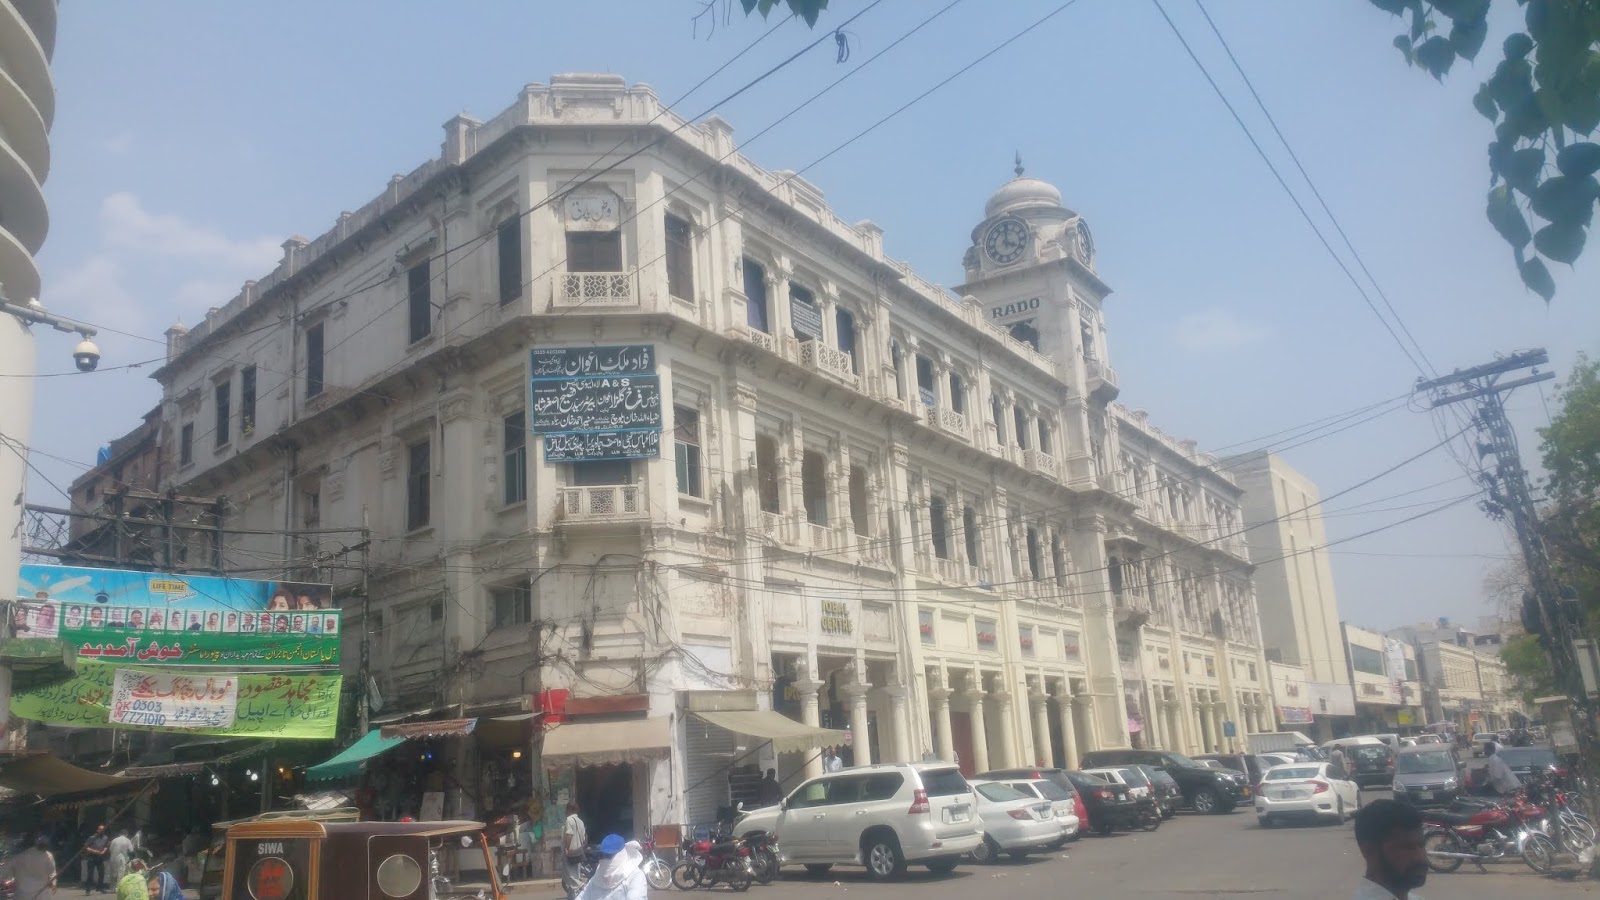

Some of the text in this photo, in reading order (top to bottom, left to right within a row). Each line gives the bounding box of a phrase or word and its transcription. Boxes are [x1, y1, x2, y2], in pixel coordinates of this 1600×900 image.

[992, 297, 1040, 319] RADO
[565, 351, 598, 375] اعوان
[600, 346, 629, 371] ملک
[601, 379, 610, 387] A
[621, 378, 630, 387] S
[153, 582, 185, 591] LIFE TIME
[820, 616, 853, 634] CENTRE
[79, 637, 141, 660] آمدید
[137, 641, 183, 661] خوش
[265, 647, 287, 660] تاجران
[286, 642, 303, 660] انجمن
[302, 646, 326, 661] پاکستان
[195, 677, 232, 701] موبائل
[241, 676, 292, 699] مقصود
[277, 678, 316, 703] مجاہد
[133, 699, 162, 712] 0303
[237, 700, 270, 723] اپیل
[120, 711, 167, 726] 7771010
[258, 842, 284, 855] SIWA
